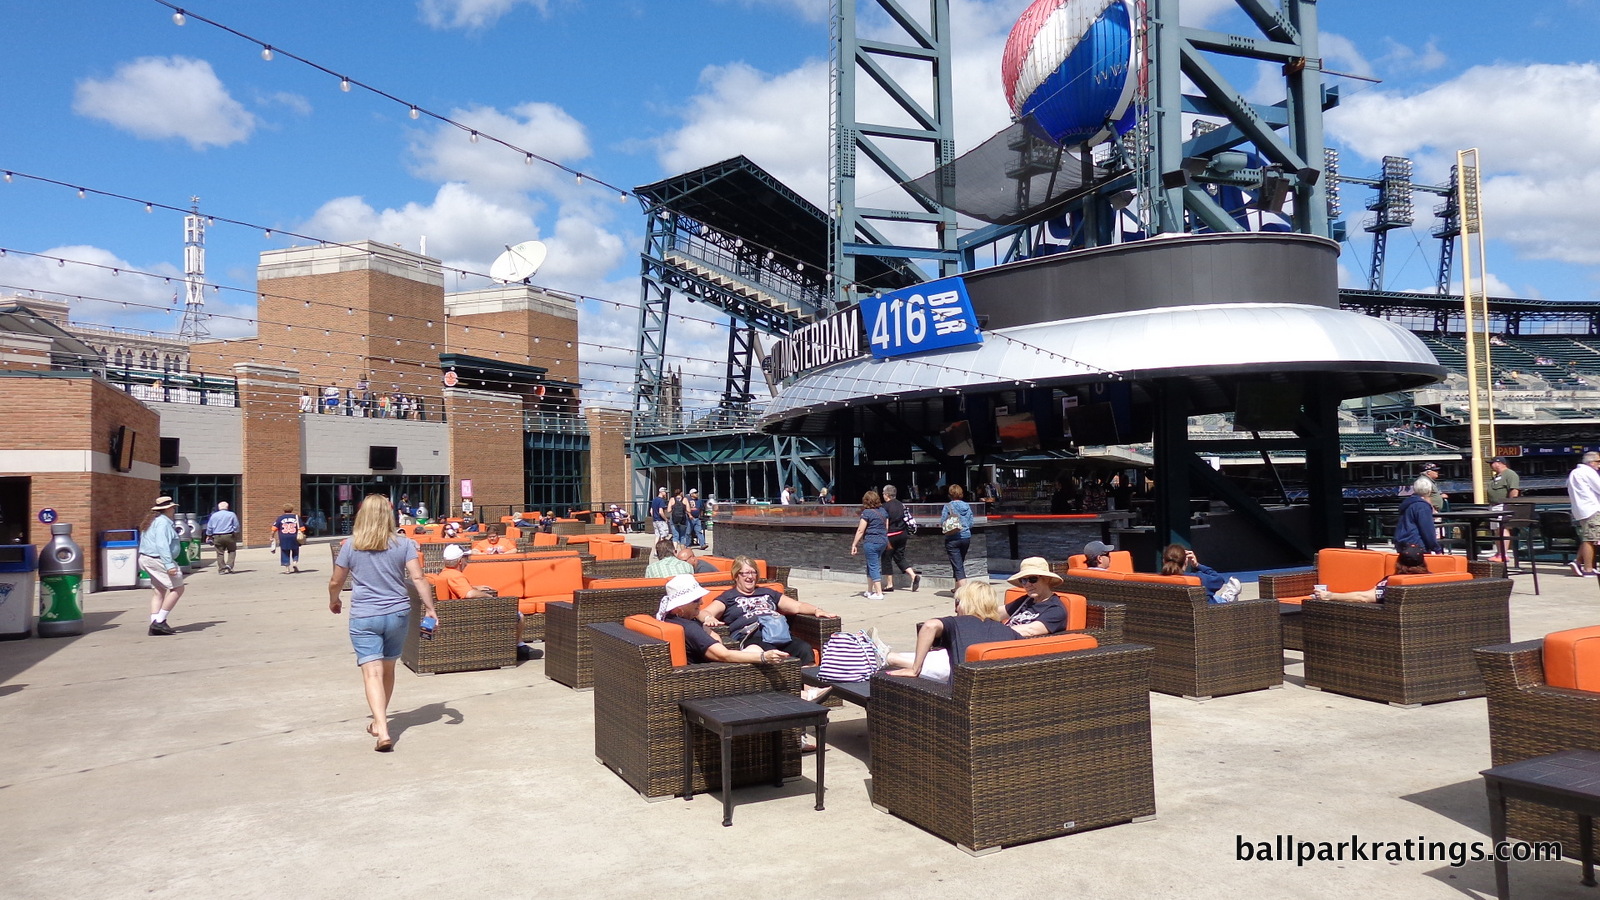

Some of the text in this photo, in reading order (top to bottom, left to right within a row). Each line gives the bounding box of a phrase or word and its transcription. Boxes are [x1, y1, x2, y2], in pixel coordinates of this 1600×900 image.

[871, 294, 926, 350] 416
[927, 290, 967, 336] BAR
[780, 309, 859, 379] AMSTERDAM
